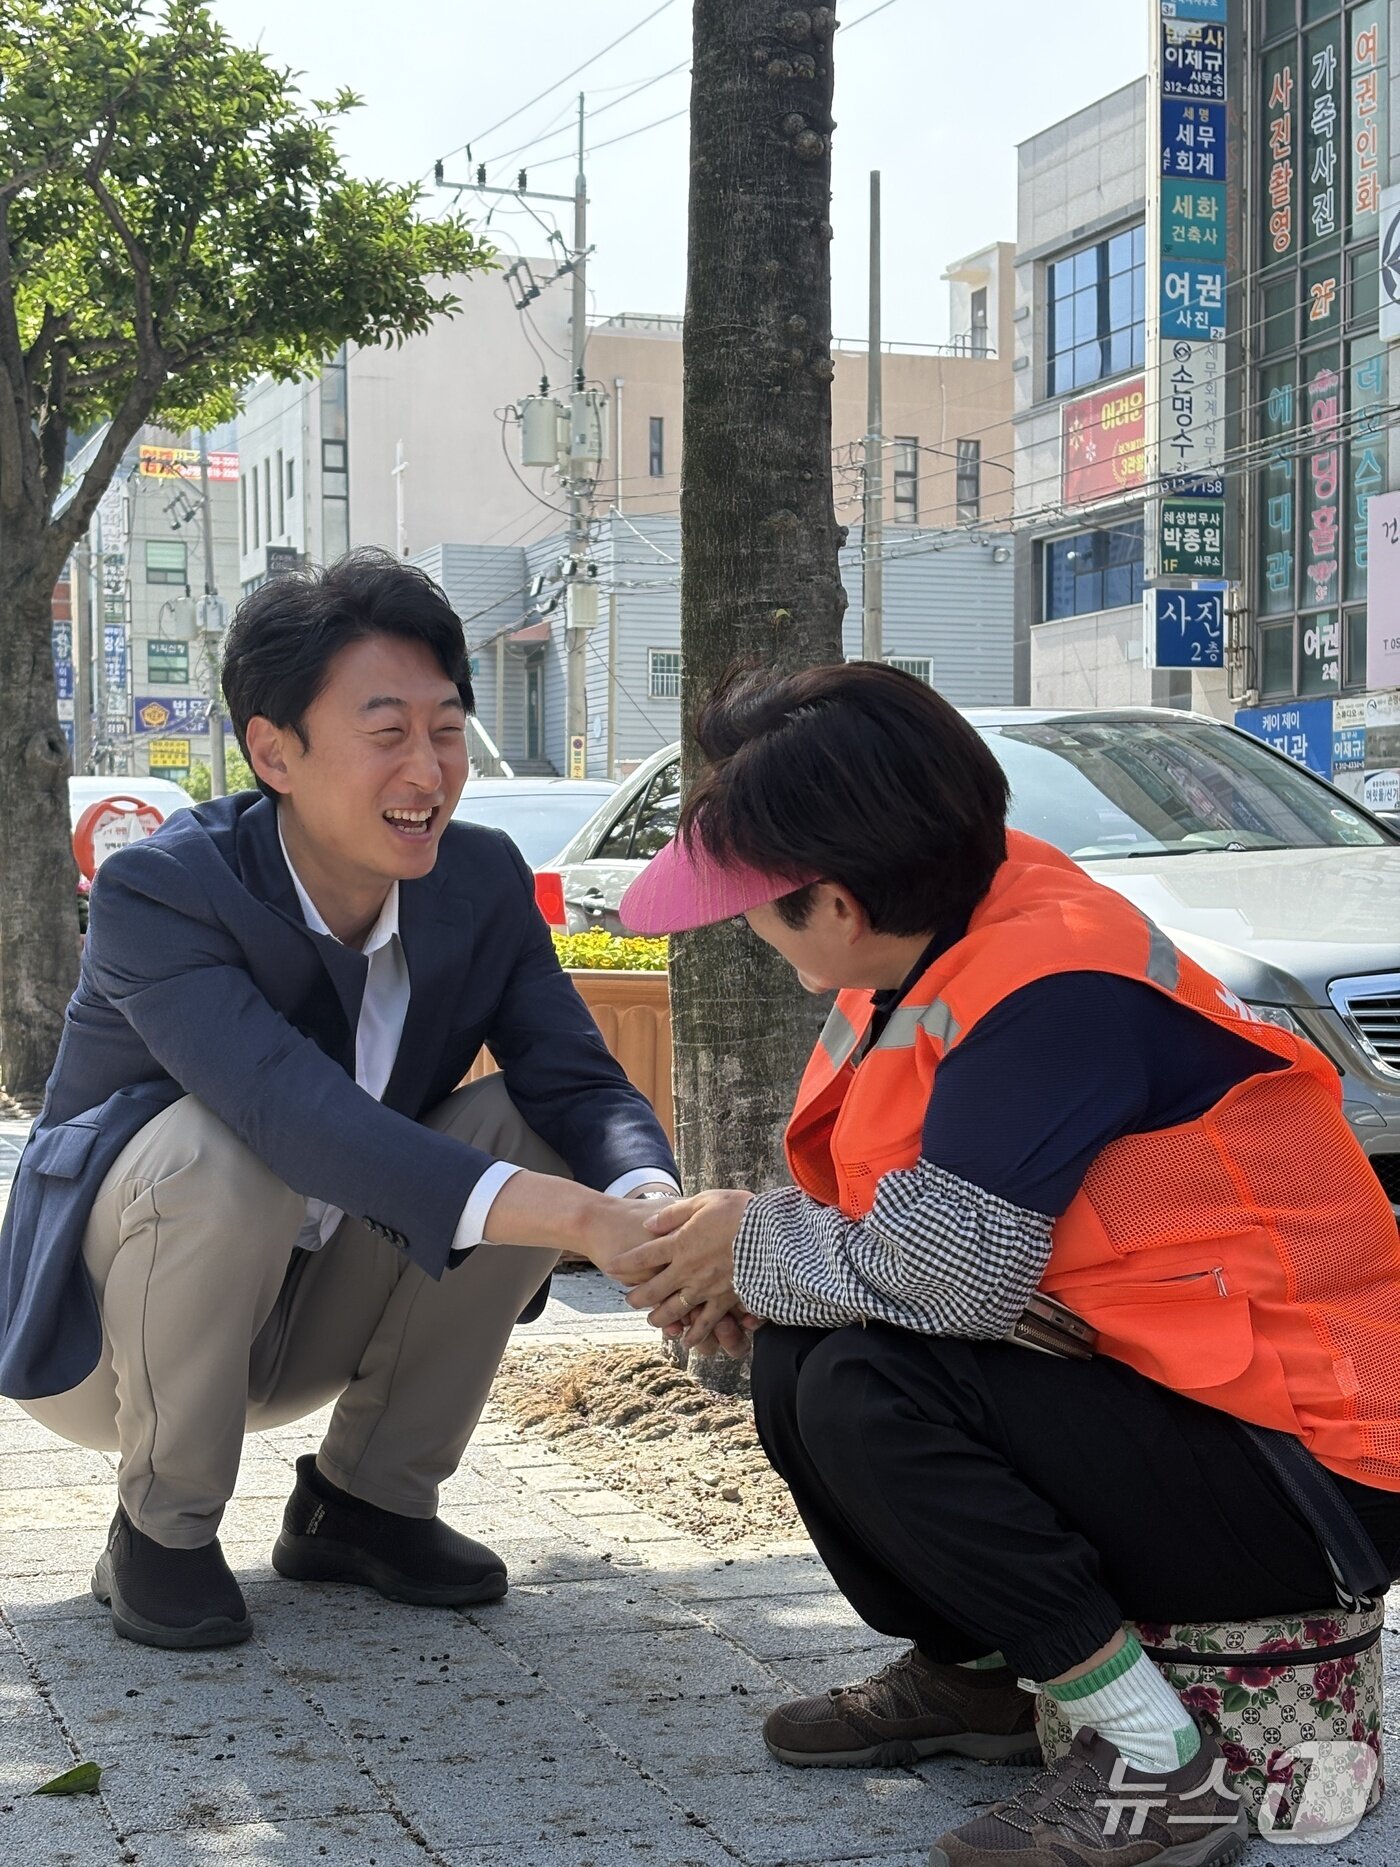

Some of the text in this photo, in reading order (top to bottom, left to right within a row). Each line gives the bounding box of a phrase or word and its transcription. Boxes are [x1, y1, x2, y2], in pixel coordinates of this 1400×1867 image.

[1165, 46, 1223, 72] 이제규
[1164, 81, 1223, 97] 312-4334-5
[1190, 71, 1224, 85] 사무소
[1175, 123, 1216, 149] 세무
[1311, 44, 1337, 237] 가족사진
[1175, 150, 1215, 176] 회계
[1269, 66, 1293, 253] 사진촬영
[1172, 194, 1219, 222] 세화
[1171, 225, 1219, 245] 건축사
[1165, 271, 1222, 308] 여권
[1310, 278, 1336, 322] 2F
[1176, 309, 1209, 330] 사진
[1170, 364, 1194, 458] 손명수
[1203, 343, 1219, 467] 세무회계사무
[1164, 527, 1221, 553] 박종원
[1163, 559, 1179, 574] 1F
[1194, 555, 1221, 567] 사무소
[1159, 595, 1221, 638] 사진
[1190, 641, 1221, 662] 2층
[1303, 622, 1339, 660] 여권
[1262, 711, 1300, 732] 케이 제이
[1266, 733, 1309, 757] 진관
[1334, 739, 1361, 759] 이제규
